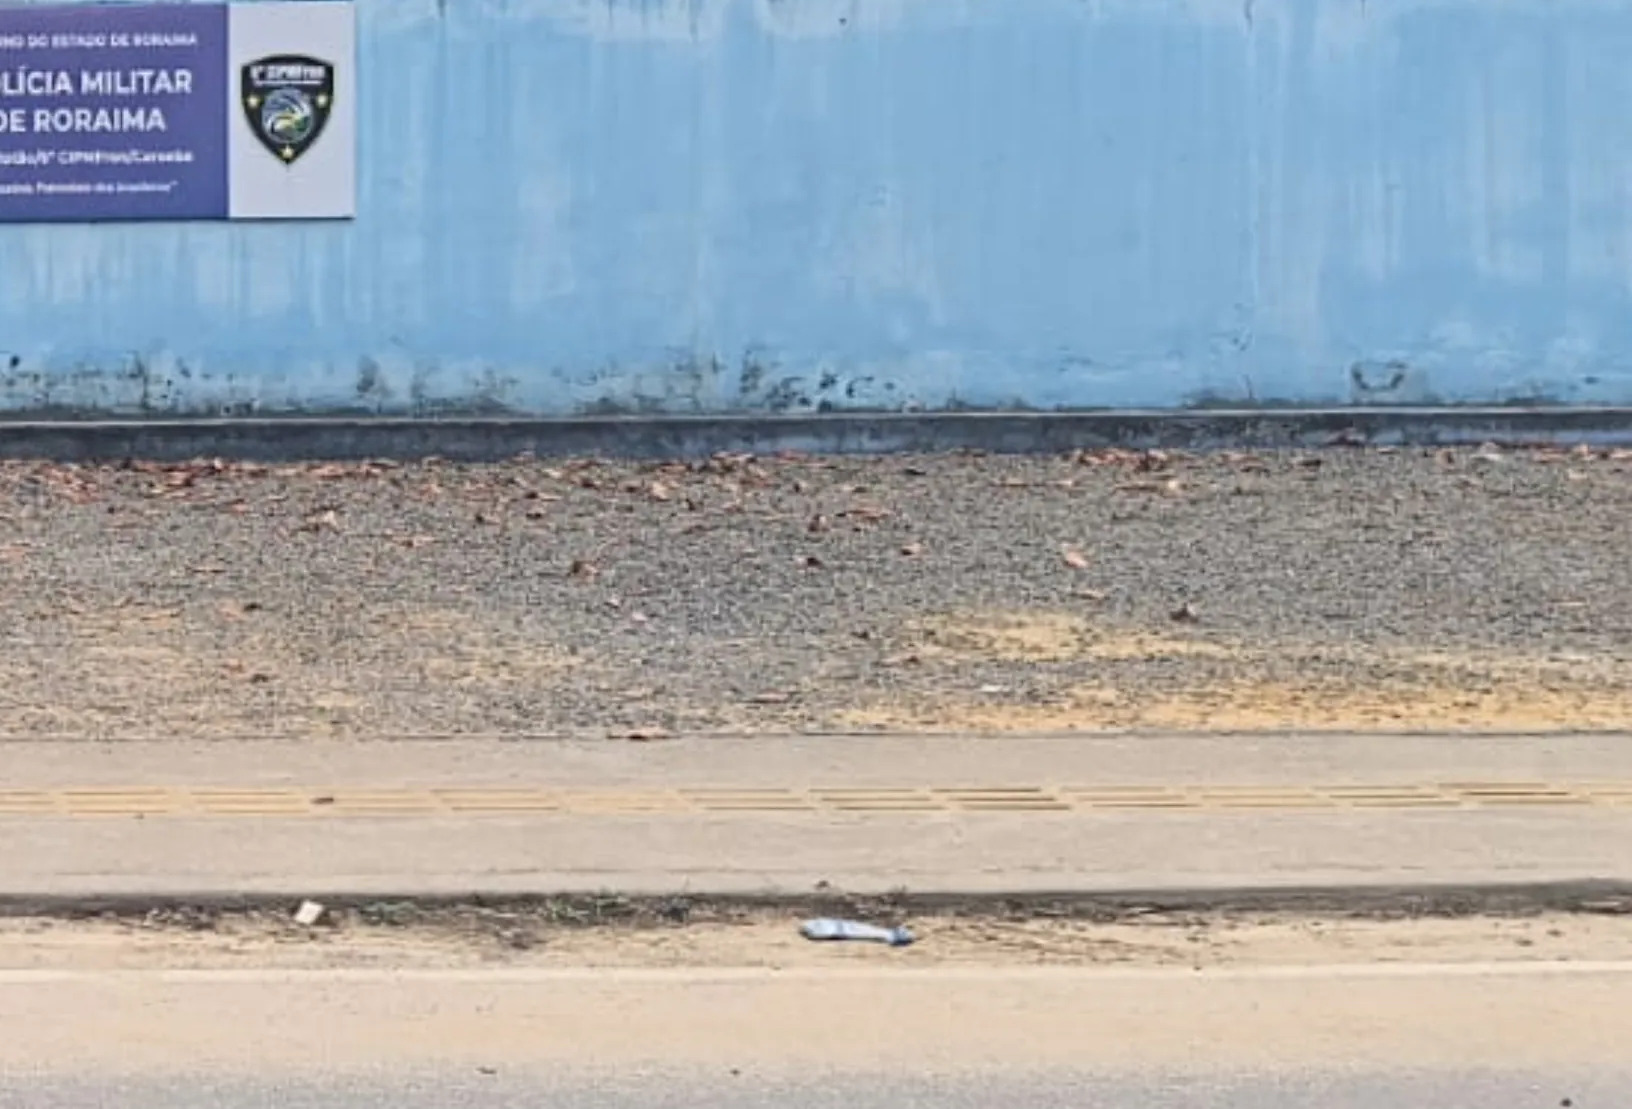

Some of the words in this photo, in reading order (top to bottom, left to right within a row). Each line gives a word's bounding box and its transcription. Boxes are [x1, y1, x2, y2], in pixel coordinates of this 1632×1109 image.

[27, 34, 49, 48] DO
[51, 33, 106, 48] ESTADO
[110, 32, 130, 47] DE
[133, 31, 198, 46] RORAIMA
[80, 68, 193, 95] MILITAR
[32, 107, 167, 133] RORAIMA
